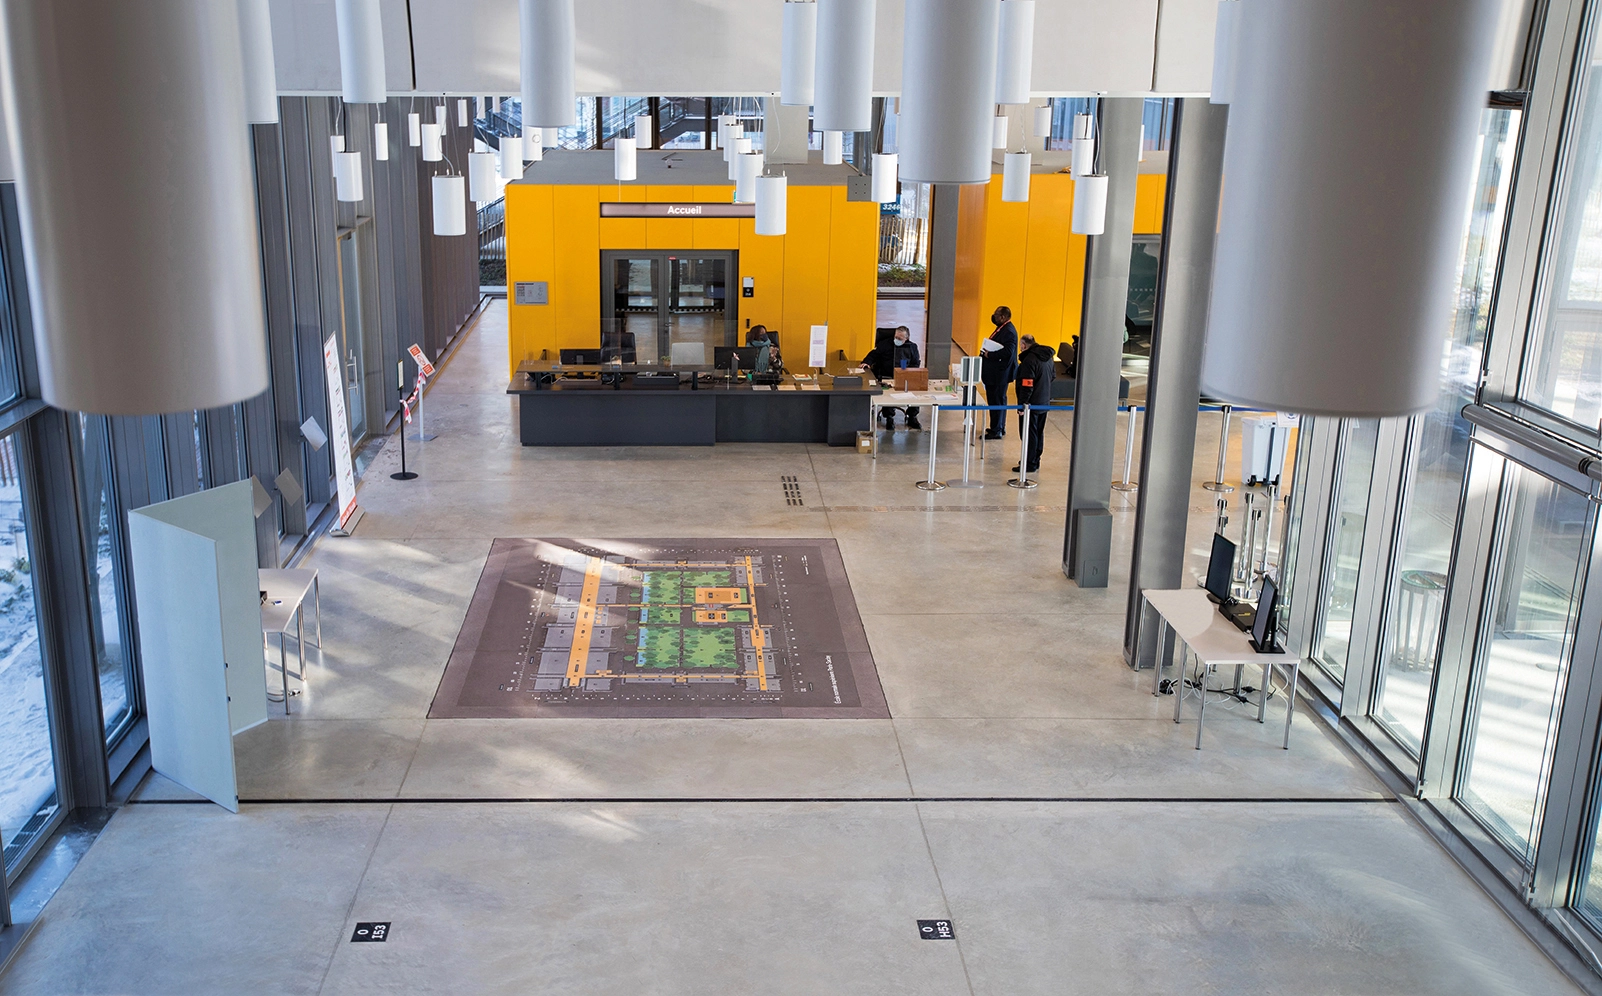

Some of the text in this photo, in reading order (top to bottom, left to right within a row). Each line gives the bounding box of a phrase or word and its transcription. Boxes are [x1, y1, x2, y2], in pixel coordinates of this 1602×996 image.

[667, 205, 702, 215] Accueil
[371, 925, 386, 939] I53
[936, 921, 950, 937] H53
